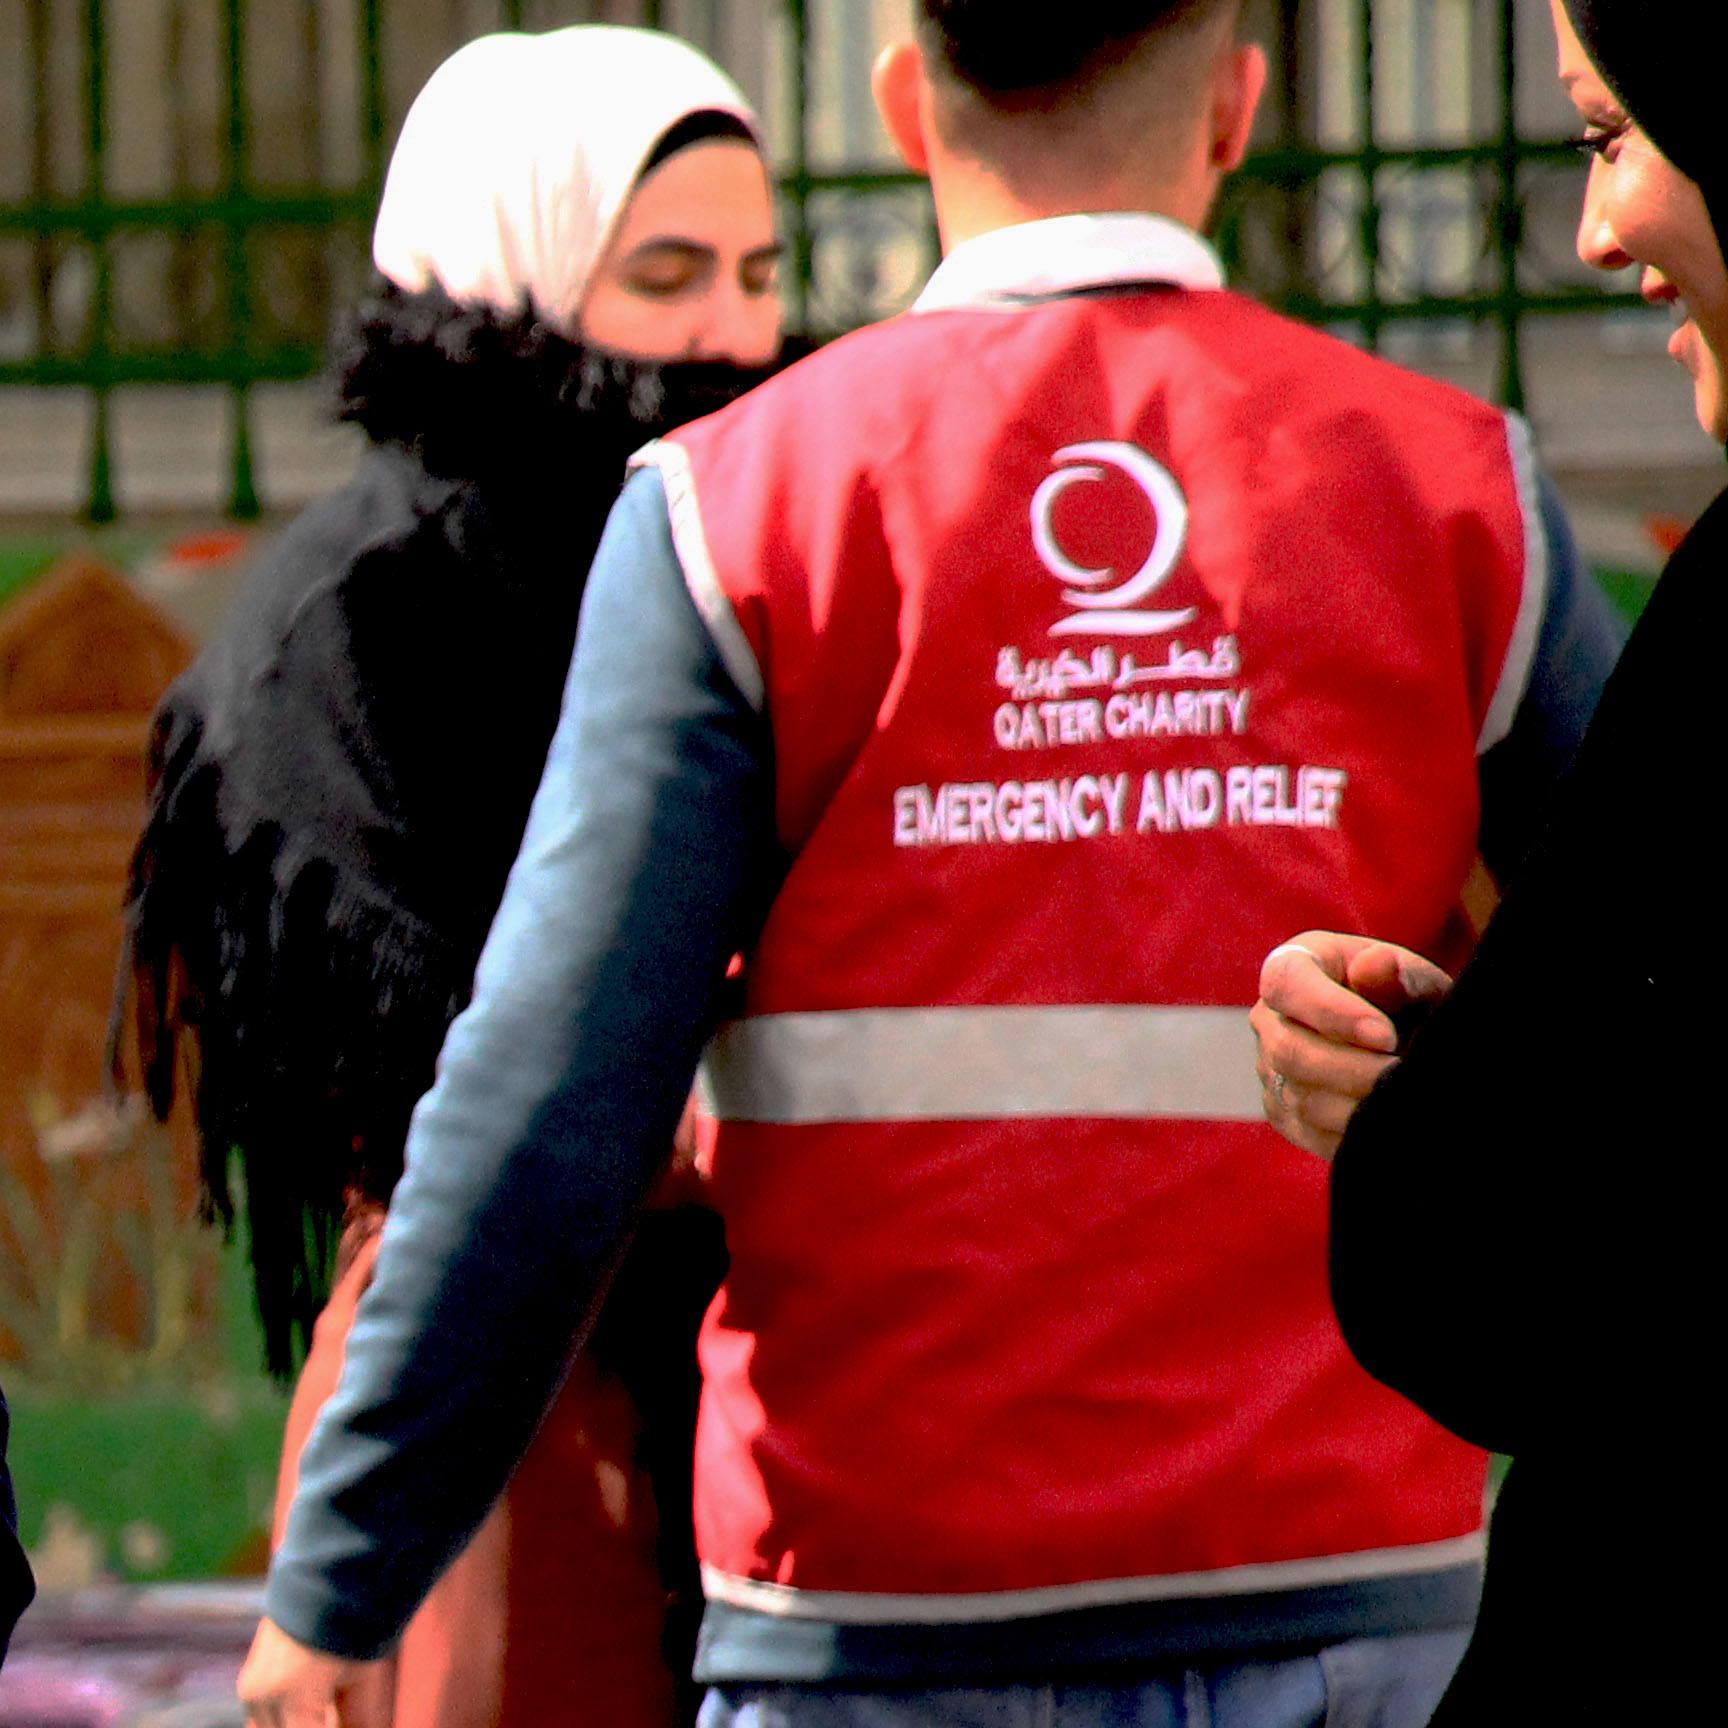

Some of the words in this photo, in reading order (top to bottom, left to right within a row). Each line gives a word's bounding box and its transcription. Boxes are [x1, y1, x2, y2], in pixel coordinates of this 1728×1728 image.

[1112, 634, 1241, 690] قطر
[994, 698, 1104, 751] QATER
[1105, 687, 1250, 739] CHARITY
[894, 772, 1130, 848] EMERGENCY
[1137, 767, 1223, 834] AND
[1226, 763, 1348, 831] RELIEF
